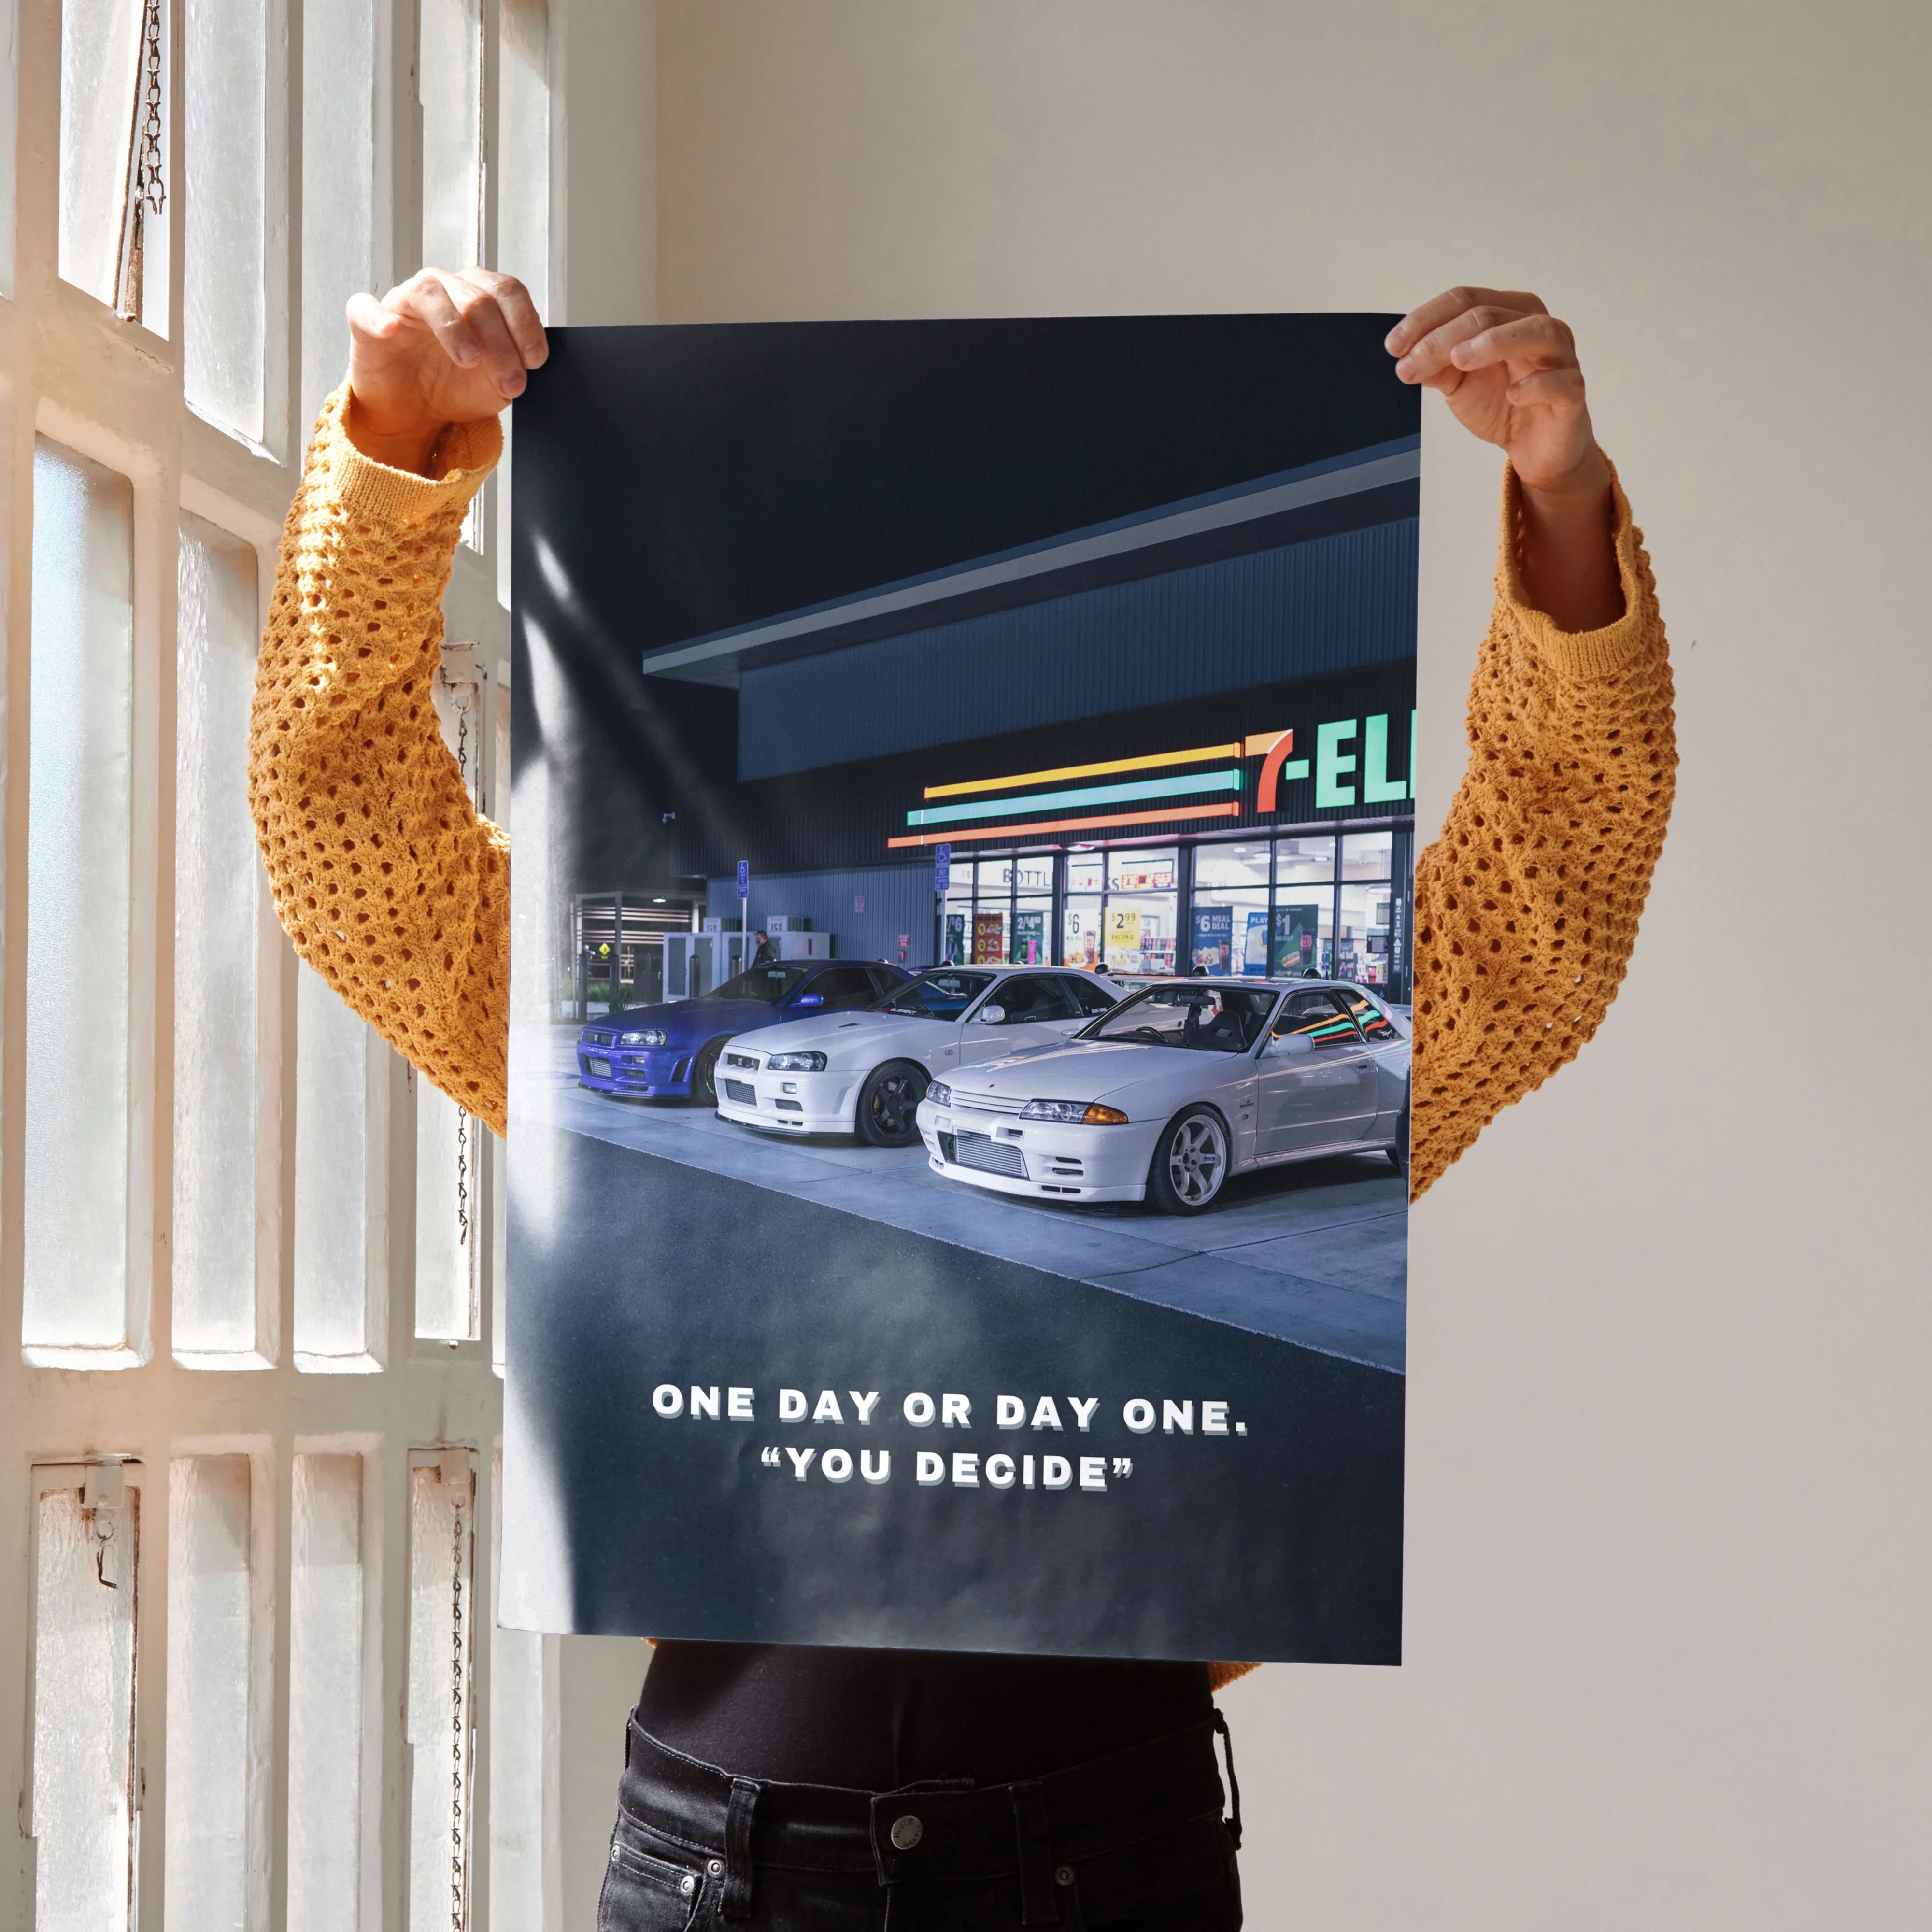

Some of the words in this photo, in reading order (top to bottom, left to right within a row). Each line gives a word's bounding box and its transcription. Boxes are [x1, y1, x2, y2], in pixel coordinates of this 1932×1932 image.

[1245, 709, 1416, 813] 7-EL
[771, 923, 782, 931] ICE
[946, 916, 962, 933] /$6
[1068, 912, 1079, 934] $6
[1195, 915, 1210, 932] $6
[1276, 913, 1290, 935] $1
[652, 1384, 754, 1421] ONE
[779, 1389, 881, 1425] DAY
[903, 1392, 972, 1429] OR
[996, 1395, 1100, 1432] DAY
[1123, 1398, 1248, 1436] ONE.
[761, 1447, 891, 1485] “YOU
[916, 1451, 1133, 1492] DECIDE”
